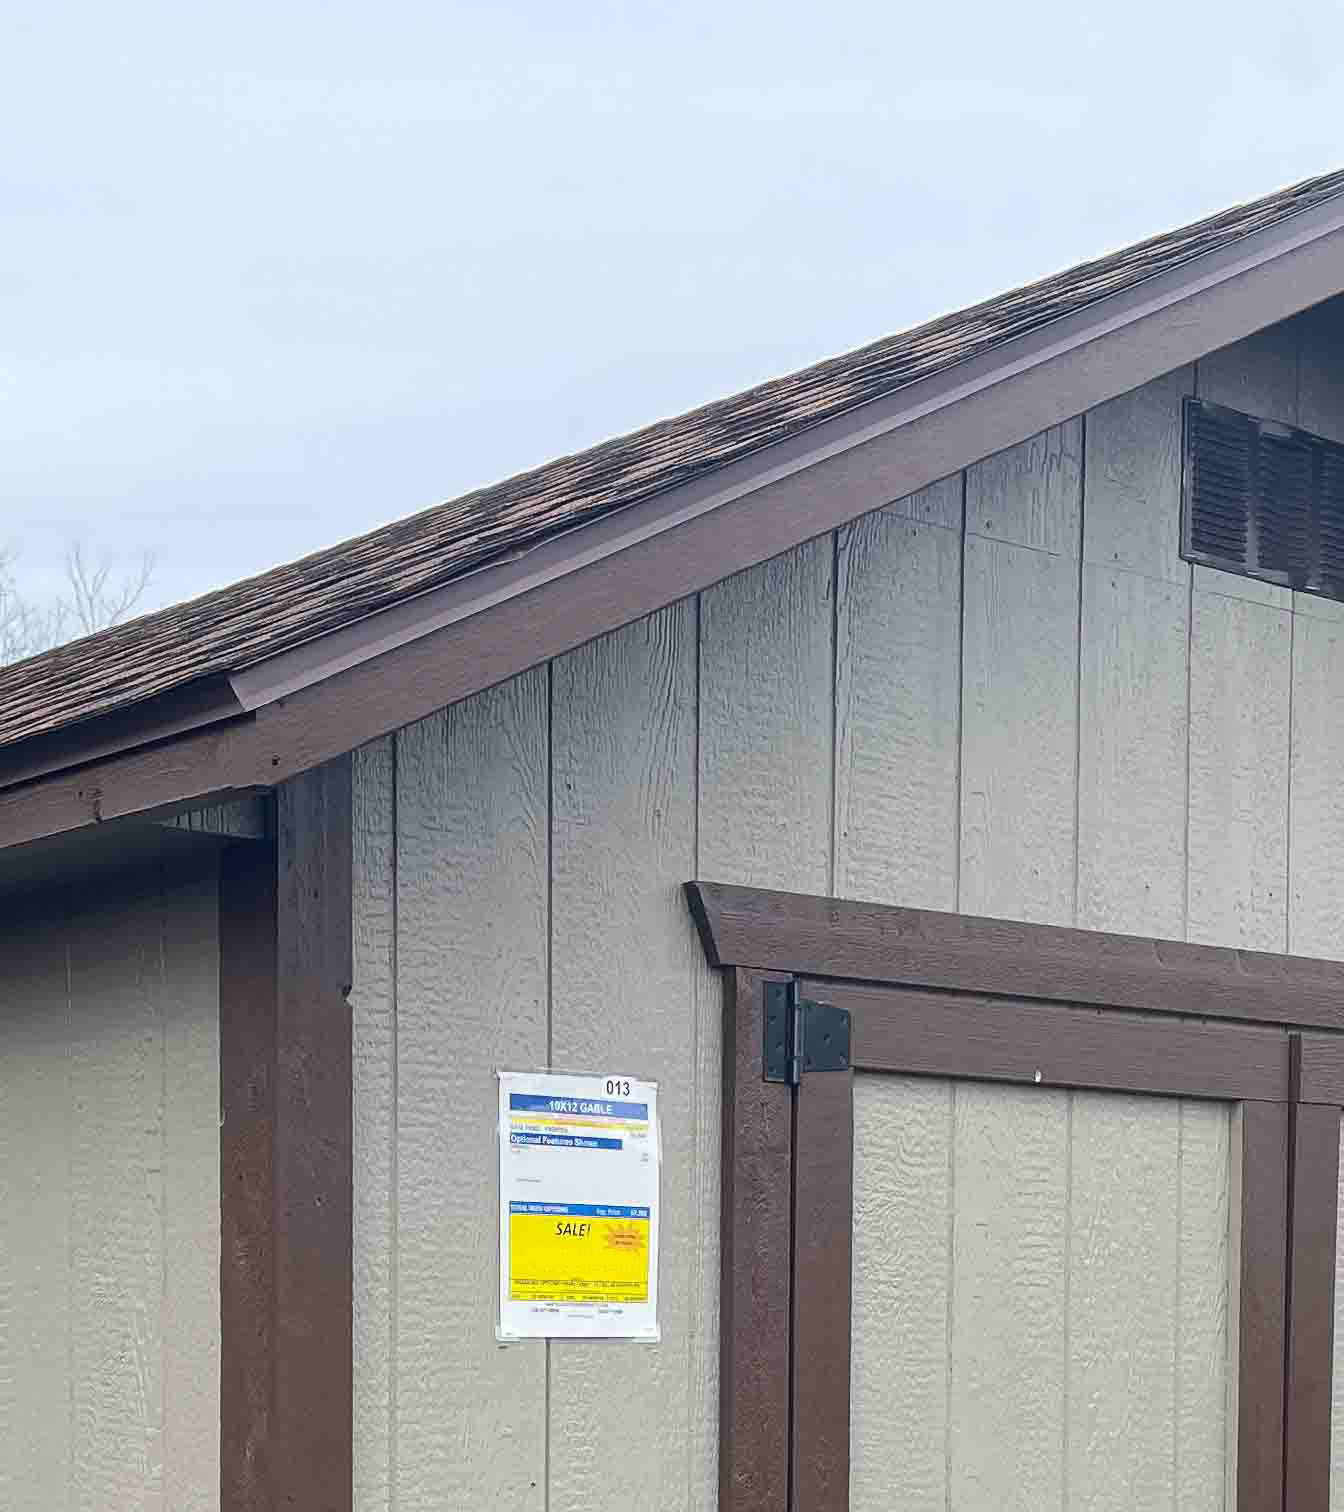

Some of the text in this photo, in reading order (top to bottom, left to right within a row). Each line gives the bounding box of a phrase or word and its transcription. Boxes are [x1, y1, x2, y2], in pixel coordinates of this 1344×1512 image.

[606, 1080, 630, 1096] 013
[549, 1101, 577, 1112] 10X12
[556, 1223, 591, 1237] SALE!
